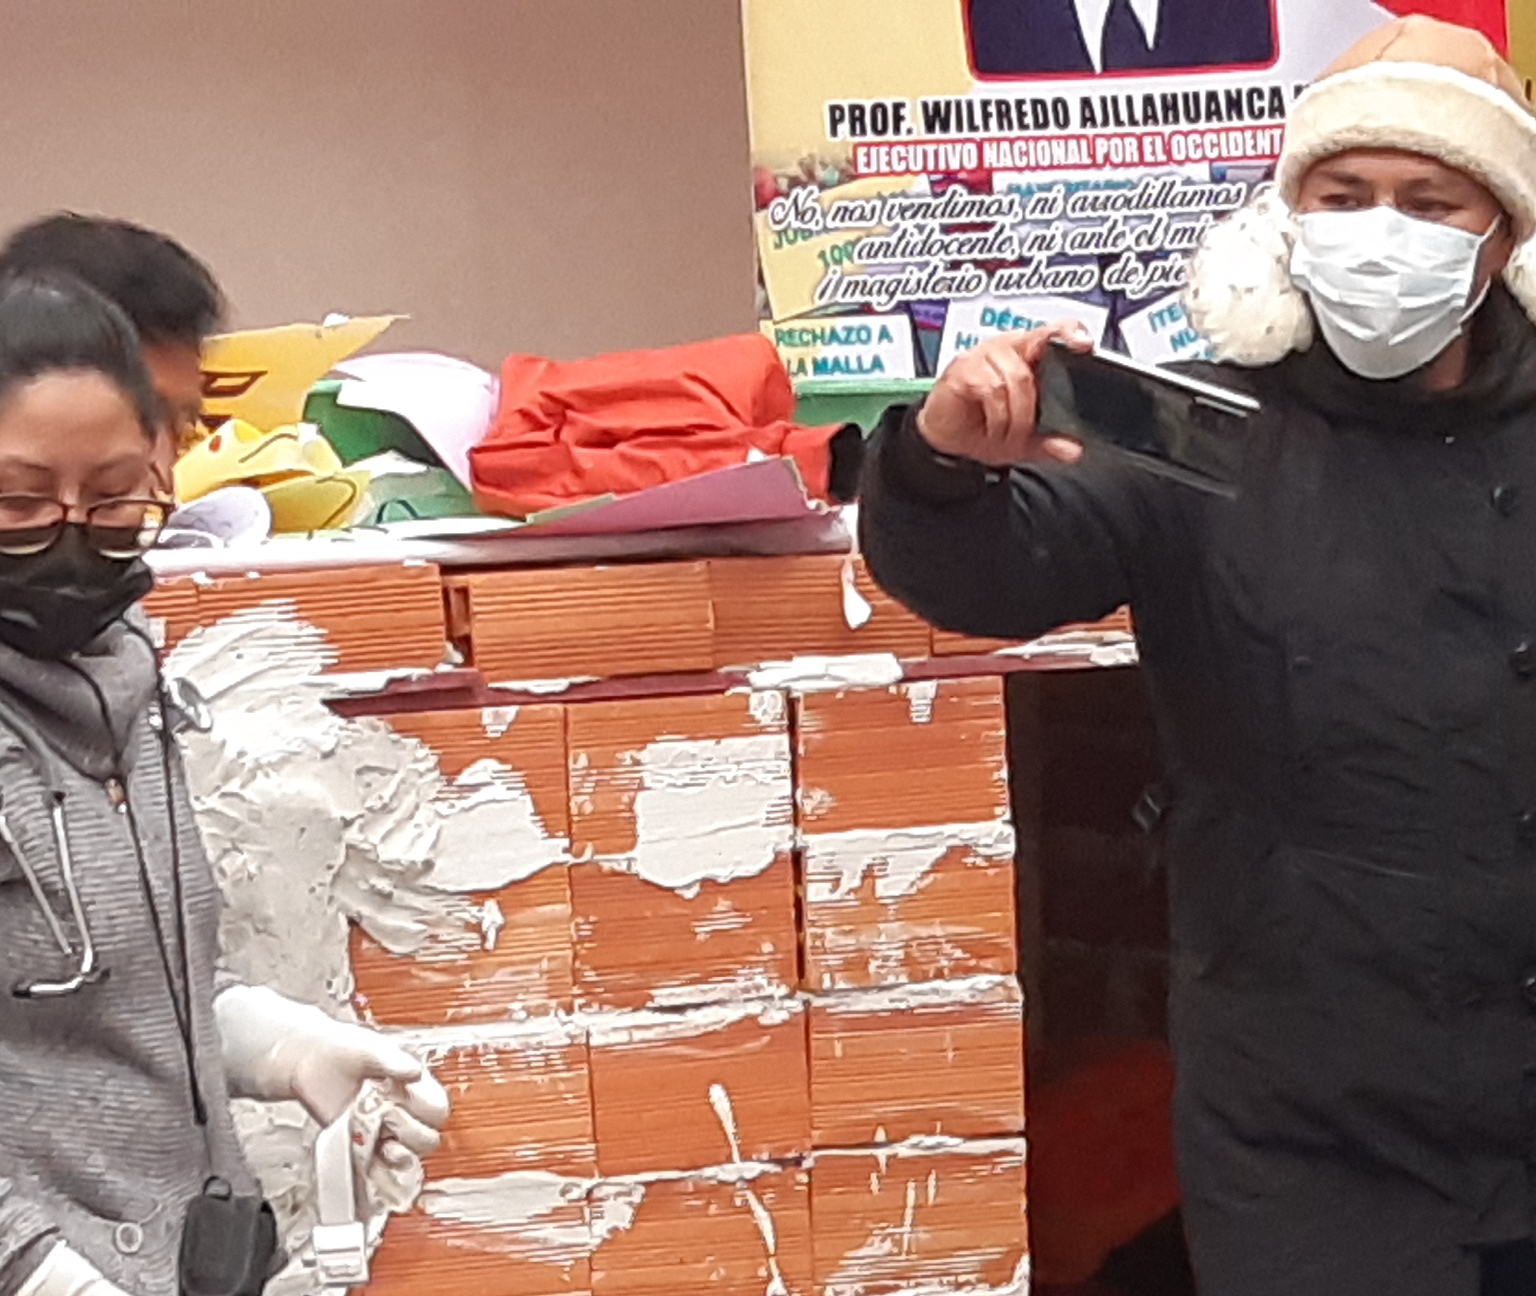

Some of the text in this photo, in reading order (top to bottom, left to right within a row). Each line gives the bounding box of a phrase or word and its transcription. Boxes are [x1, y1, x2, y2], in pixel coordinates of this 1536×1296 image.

[827, 101, 913, 138] PROF.
[921, 96, 1071, 134] WILFREDO
[856, 142, 979, 174] EJECUTIVO
[983, 136, 1093, 169] NACIONAL
[1095, 135, 1140, 164] POR
[1141, 134, 1167, 162] EL
[831, 204, 875, 224] nos
[886, 189, 1020, 222] vendimos,
[1029, 188, 1061, 216] ni
[1029, 219, 1061, 250] ni
[1070, 218, 1126, 250] ante
[1133, 215, 1160, 247] el
[994, 258, 1096, 292] urbano
[774, 322, 894, 348] RECHAZO A
[786, 354, 886, 377] LA MALLA
